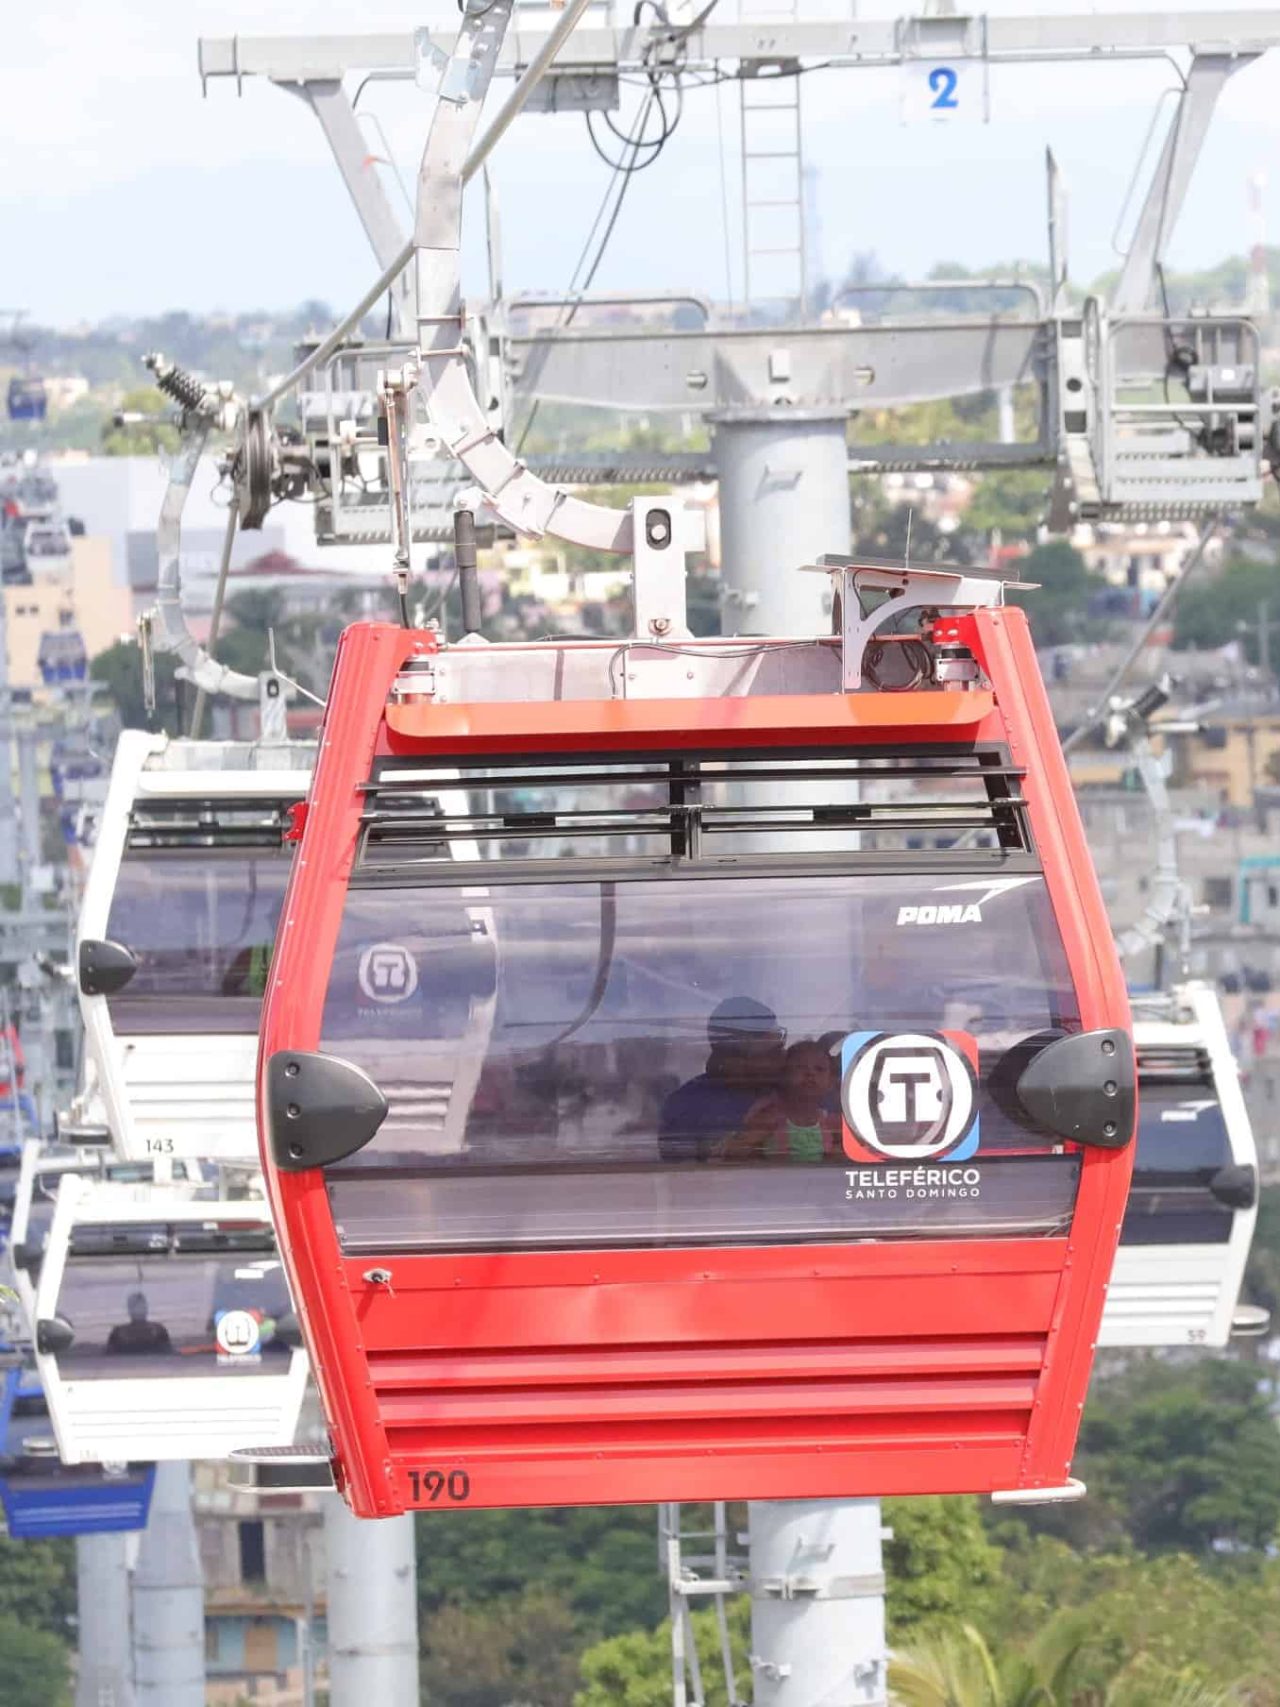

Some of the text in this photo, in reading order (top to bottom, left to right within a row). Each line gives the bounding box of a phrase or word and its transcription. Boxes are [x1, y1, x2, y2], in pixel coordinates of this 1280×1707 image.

[929, 66, 959, 109] 2
[896, 904, 982, 926] POMA
[146, 1138, 175, 1154] 143
[845, 1165, 980, 1187] TELEFÉRICO
[845, 1187, 980, 1200] SANTO DOMINGO
[407, 1469, 470, 1502] 190
